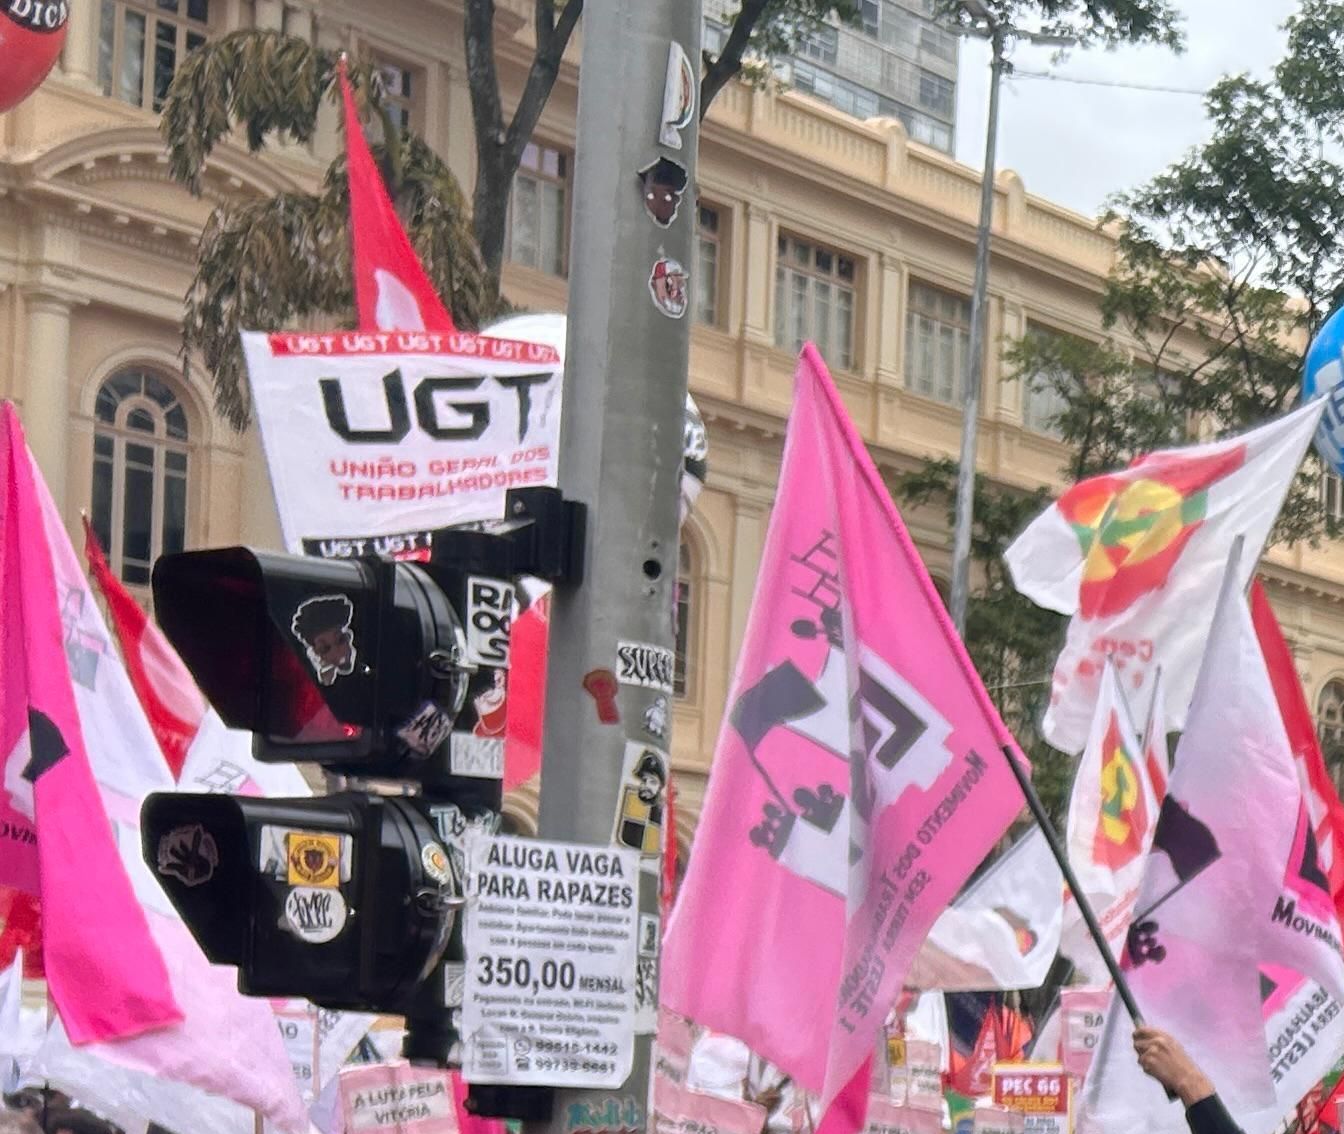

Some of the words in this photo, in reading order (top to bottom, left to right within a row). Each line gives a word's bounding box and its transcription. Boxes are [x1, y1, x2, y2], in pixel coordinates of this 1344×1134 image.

[288, 335, 333, 354] UGT
[343, 335, 390, 353] UGT
[398, 334, 442, 352] UGT
[450, 334, 487, 355] UGT
[492, 337, 524, 359] UGT
[319, 366, 553, 444] UGT
[330, 455, 417, 477] UNIÃO
[428, 457, 500, 476] GERAL
[510, 446, 550, 465] DOS
[338, 467, 548, 501] TRABALHADORES
[319, 538, 368, 558] UGT
[374, 533, 425, 553] UGT
[487, 843, 559, 872] ALUGA
[566, 851, 624, 878] VAGA
[477, 873, 530, 901] PARA
[538, 880, 633, 908] RAPAZES
[477, 956, 575, 995] 350,00
[579, 975, 626, 993] MENSAL
[1002, 1078, 1033, 1095] PEC
[1037, 1078, 1060, 1096] 66
